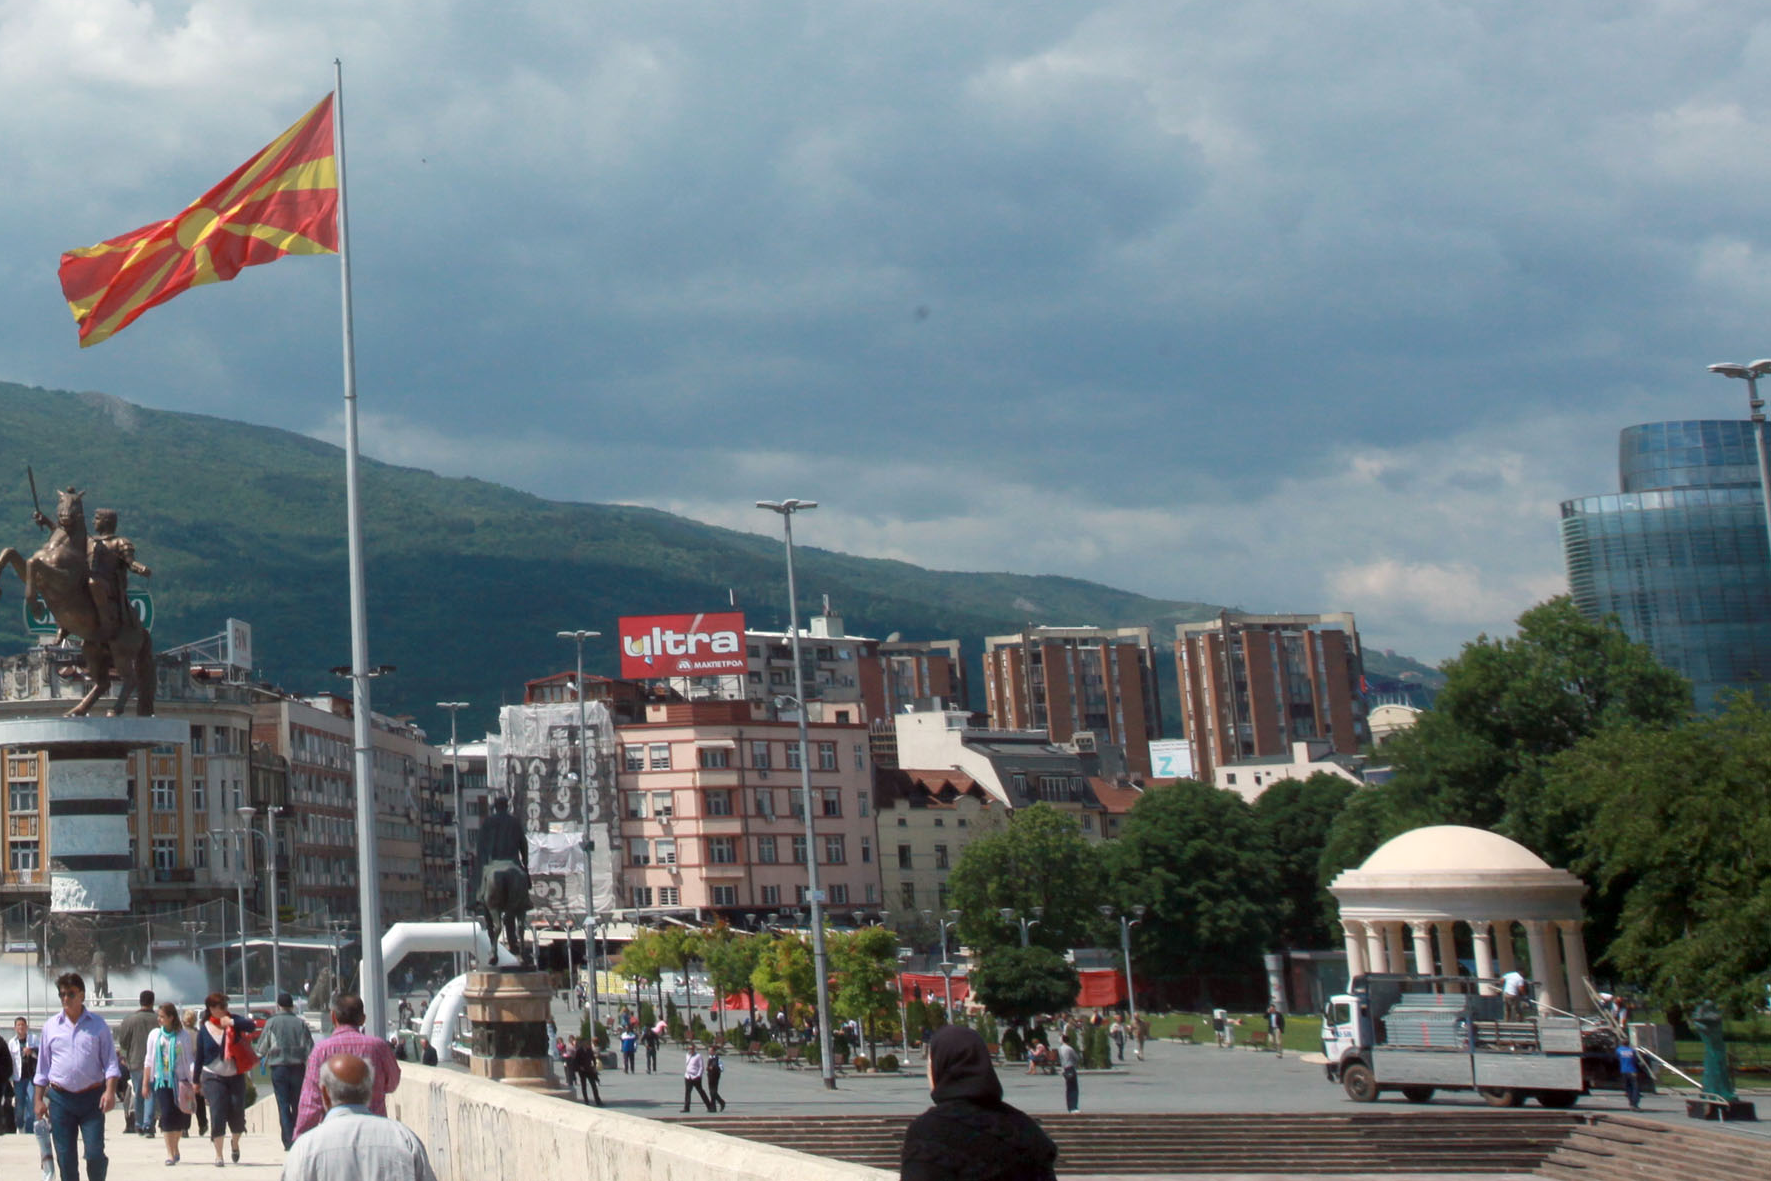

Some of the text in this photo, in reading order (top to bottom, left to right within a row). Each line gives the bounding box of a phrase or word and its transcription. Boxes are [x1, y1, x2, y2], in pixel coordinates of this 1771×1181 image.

[624, 627, 740, 657] ultra
[694, 659, 744, 669] МАКПЕТРОЛ
[551, 728, 571, 819] Ceresit
